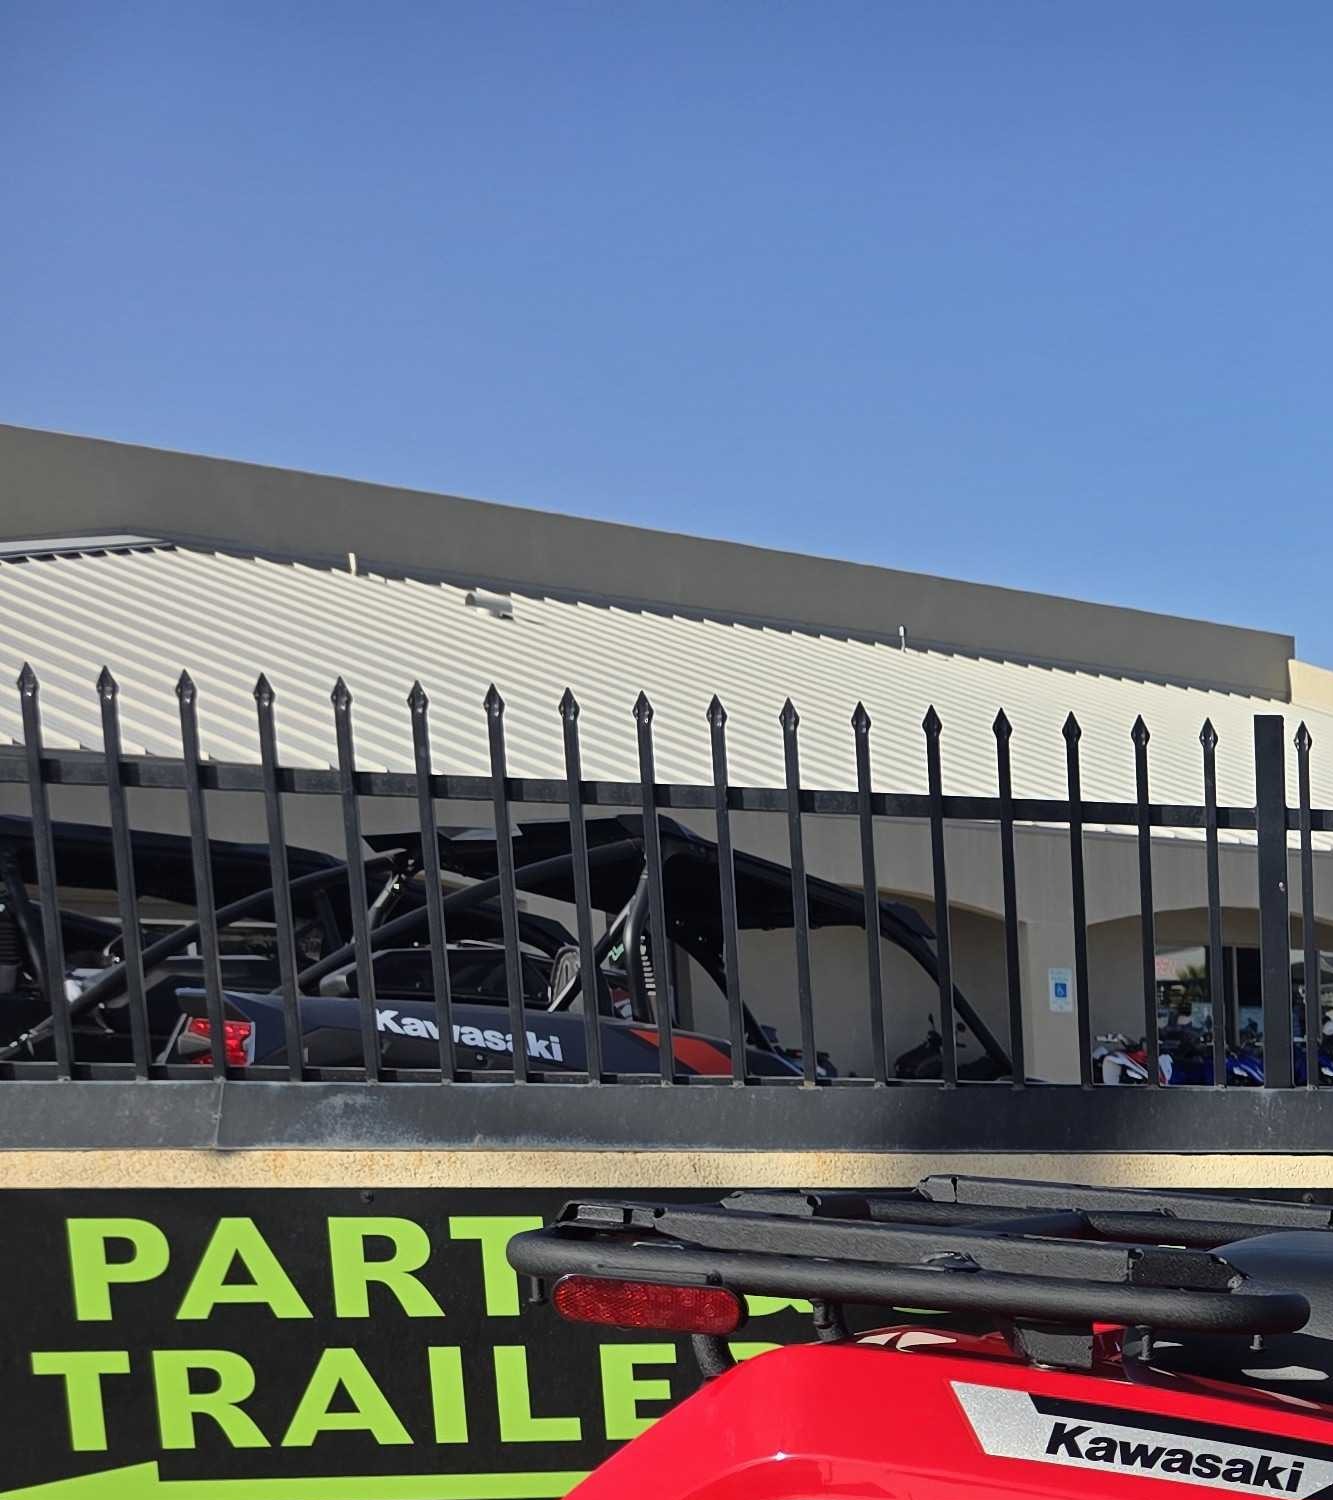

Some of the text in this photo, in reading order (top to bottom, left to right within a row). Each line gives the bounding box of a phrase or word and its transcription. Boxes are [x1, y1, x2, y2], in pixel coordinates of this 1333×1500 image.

[66, 1216, 546, 1321] PART
[31, 1341, 787, 1452] TRAILE
[1045, 1421, 1305, 1494] Kawasaki
